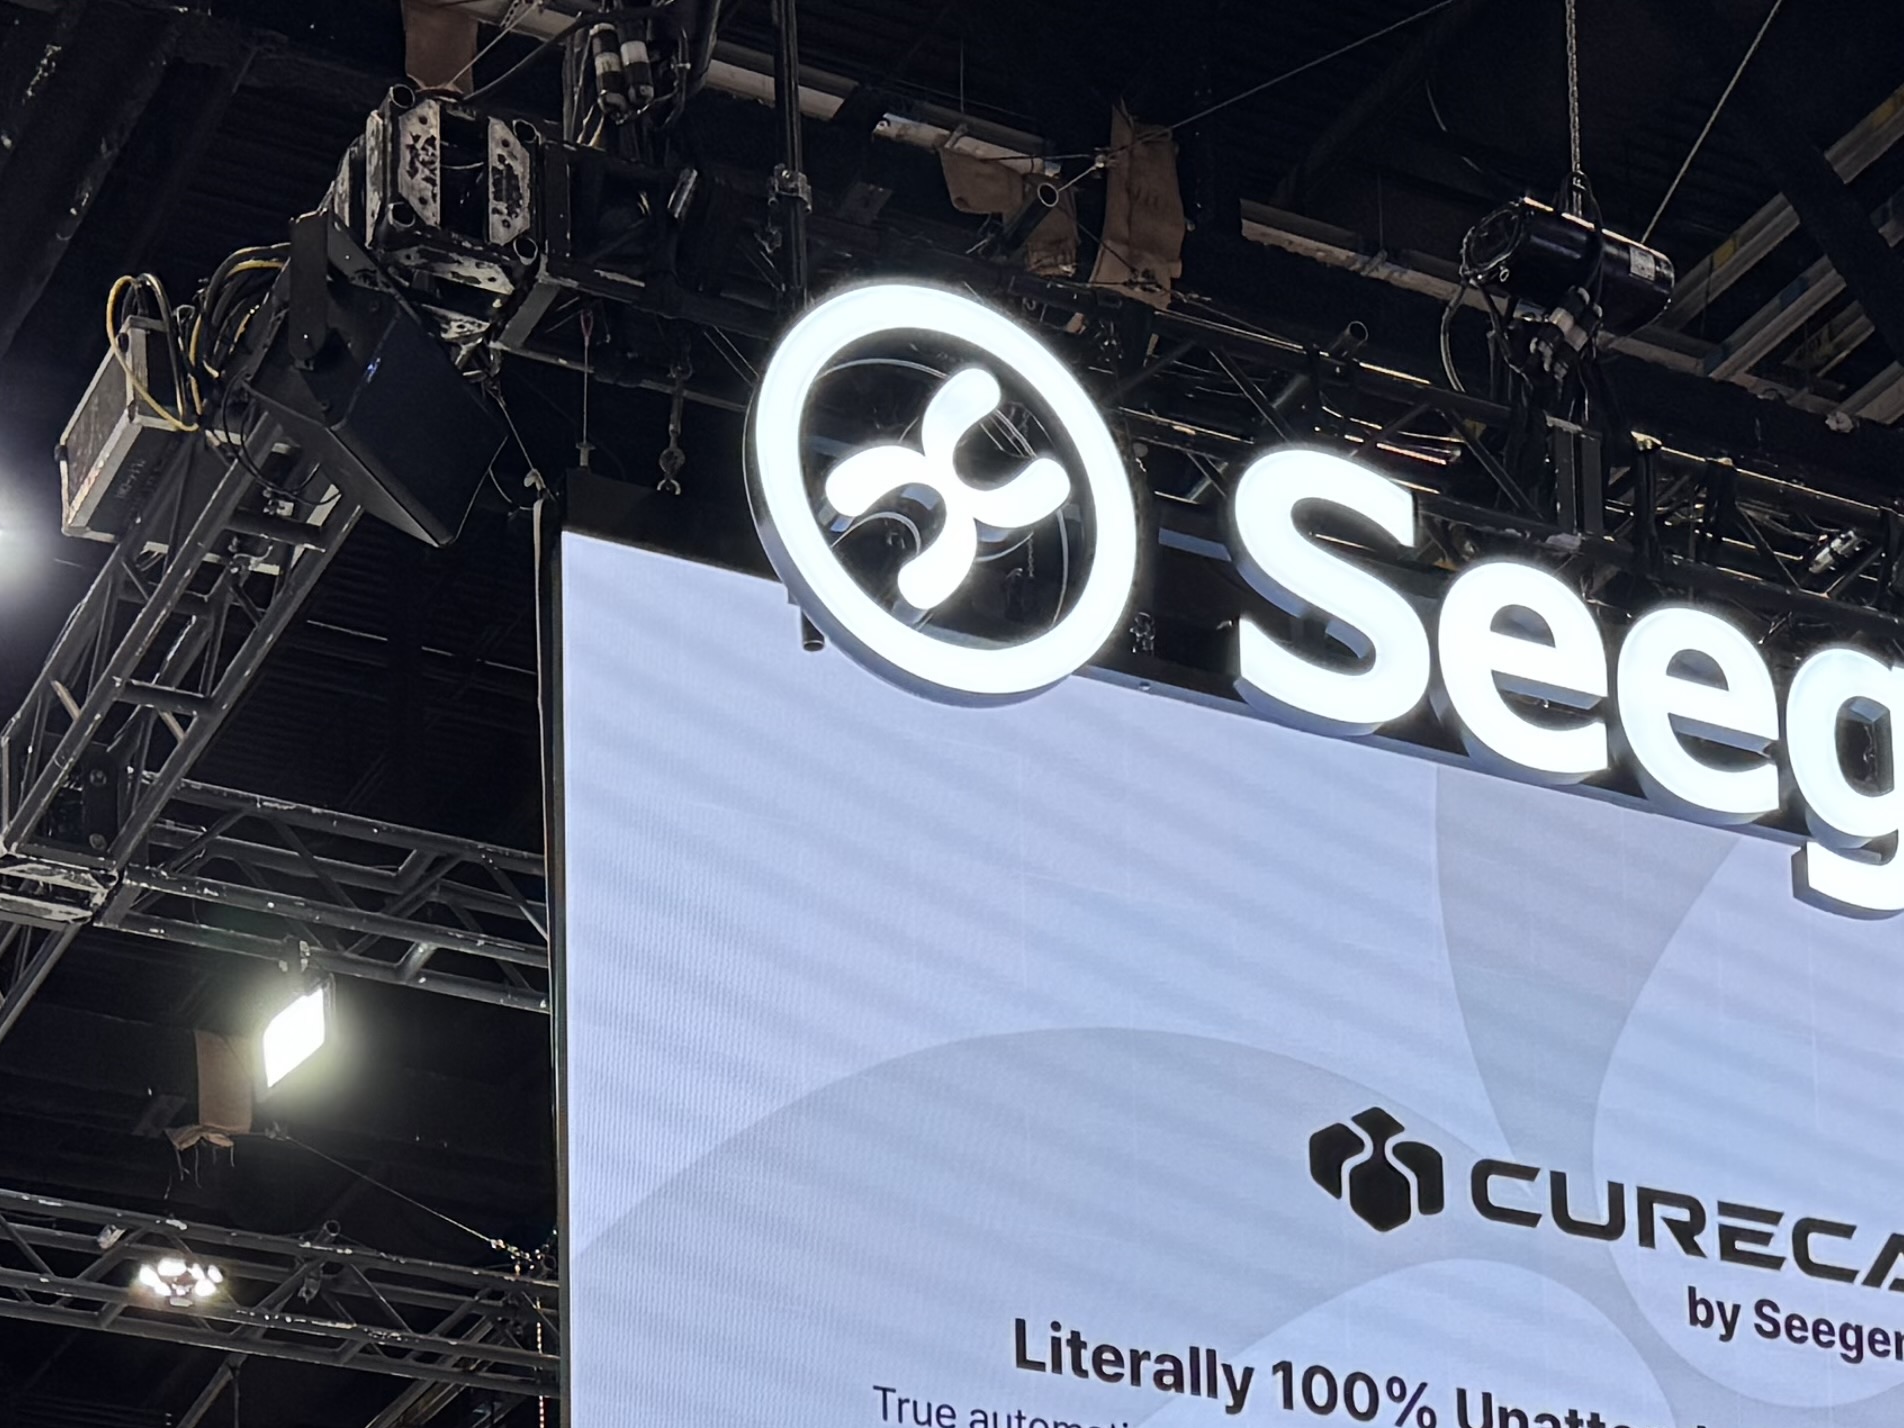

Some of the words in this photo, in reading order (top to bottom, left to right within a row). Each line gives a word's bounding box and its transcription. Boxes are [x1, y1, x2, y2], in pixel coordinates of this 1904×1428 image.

[1688, 1287, 1741, 1341] by
[1015, 1318, 1253, 1415] Literally
[873, 1385, 956, 1428] True
